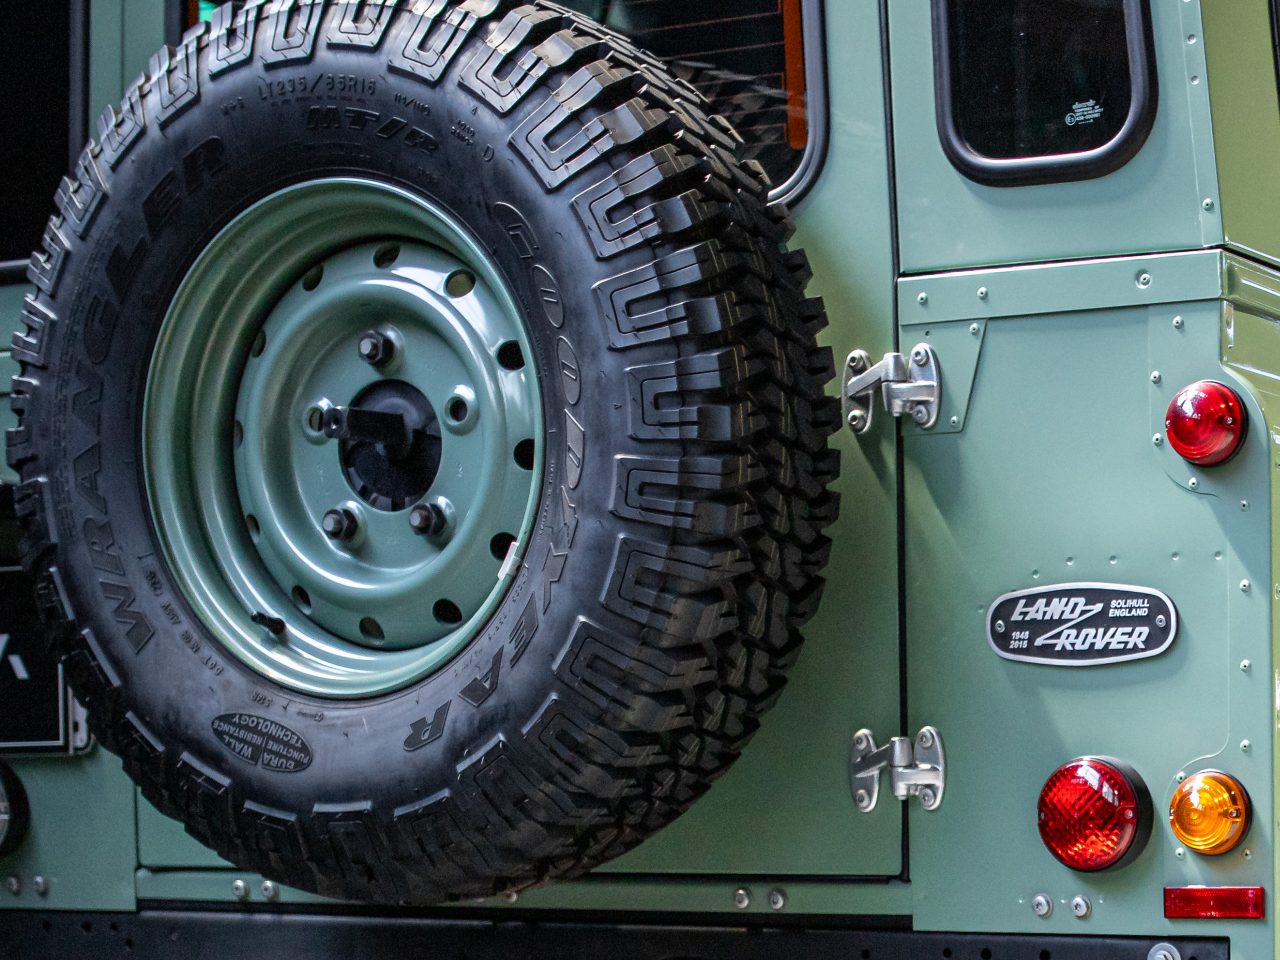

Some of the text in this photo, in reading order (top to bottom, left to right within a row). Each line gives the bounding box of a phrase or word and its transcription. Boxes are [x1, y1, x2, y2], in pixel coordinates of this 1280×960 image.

[72, 134, 228, 656] WRANGLER
[403, 200, 585, 752] GOODYEAR
[1011, 596, 1087, 622] LAND
[1108, 608, 1149, 618] ENGLAND
[1109, 598, 1150, 609] SOLIHULL
[1054, 626, 1150, 651] ROVER
[213, 719, 310, 764] PUNCTURE RESISTANCE
[232, 714, 302, 748] TECHNOLOGY
[223, 734, 295, 770] DURA WALL
